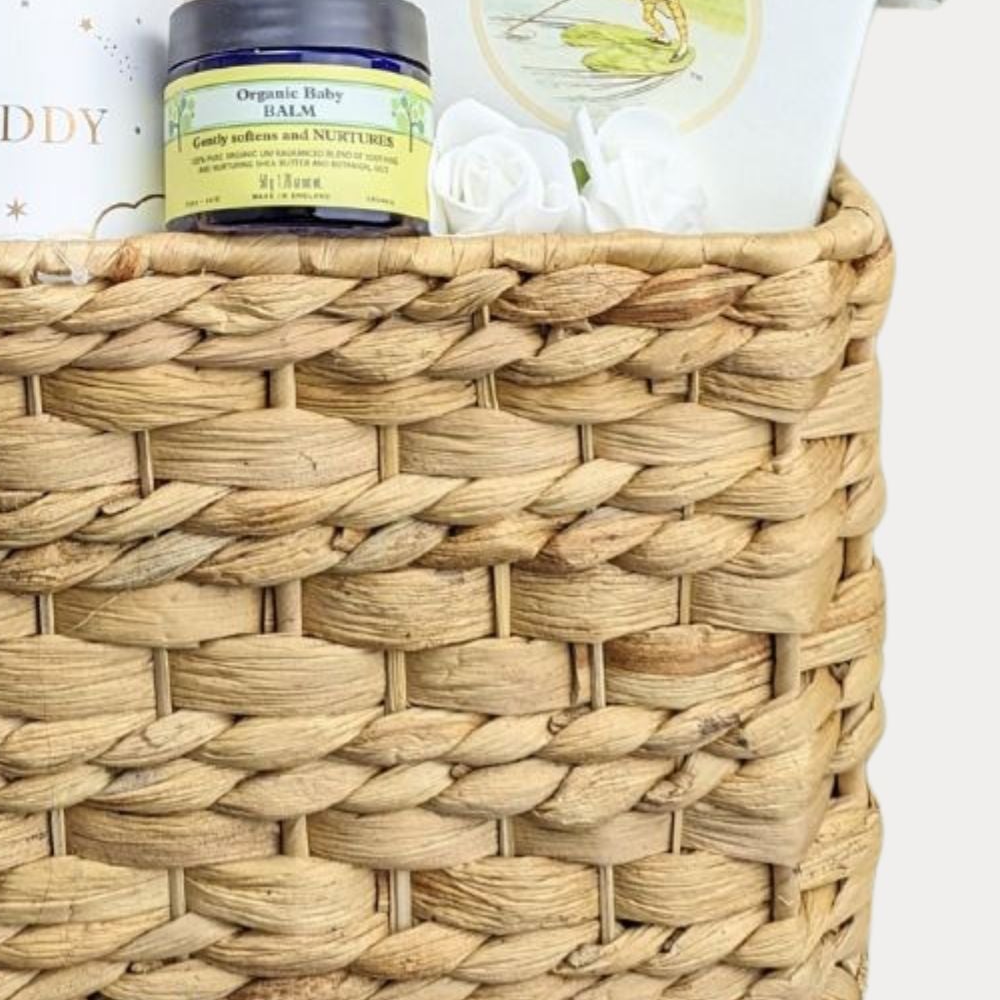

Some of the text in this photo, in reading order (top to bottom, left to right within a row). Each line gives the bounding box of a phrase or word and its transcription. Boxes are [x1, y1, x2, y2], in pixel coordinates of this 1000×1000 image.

[236, 86, 344, 103] Organic Baby
[263, 104, 317, 118] BALM
[193, 128, 395, 149] Gently softens and NURTURES
